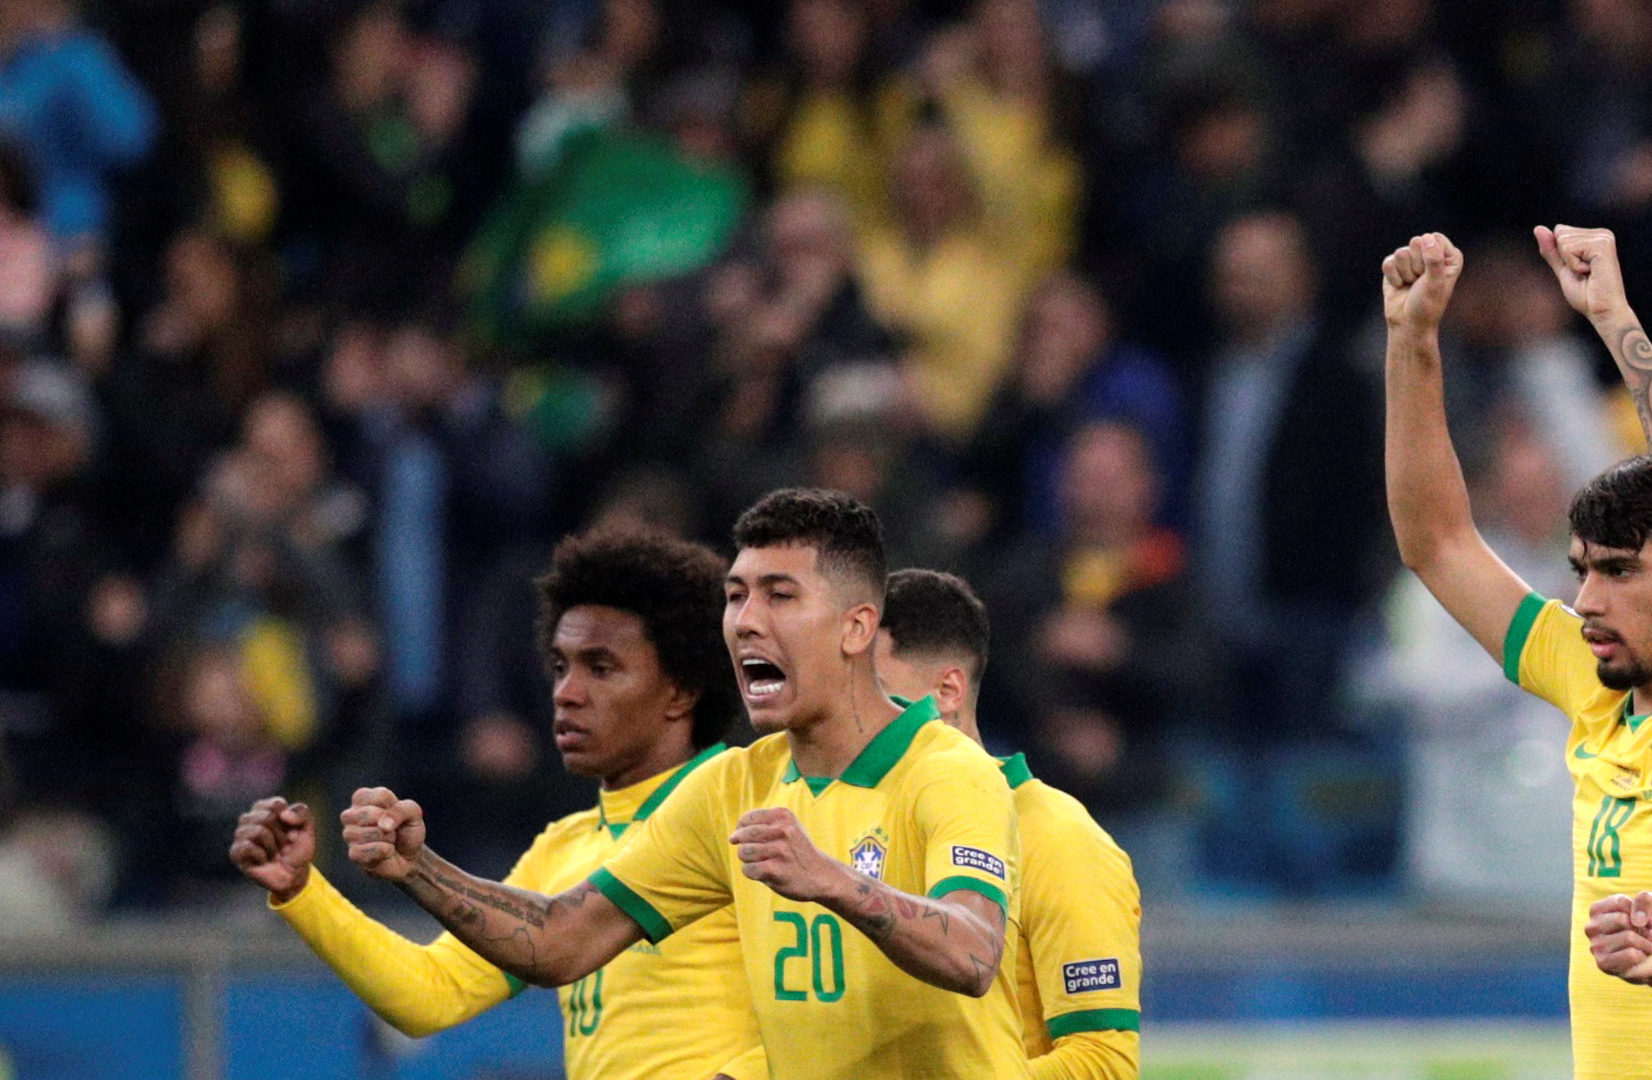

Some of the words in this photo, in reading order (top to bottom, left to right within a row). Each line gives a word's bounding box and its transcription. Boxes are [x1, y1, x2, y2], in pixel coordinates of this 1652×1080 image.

[1587, 795, 1636, 877] 18
[954, 847, 986, 862] Cree
[987, 856, 1002, 868] en
[955, 856, 1001, 876] grande
[773, 910, 846, 1003] 20
[1065, 965, 1097, 977] Cree
[1099, 963, 1116, 973] en
[1067, 973, 1115, 991] grande
